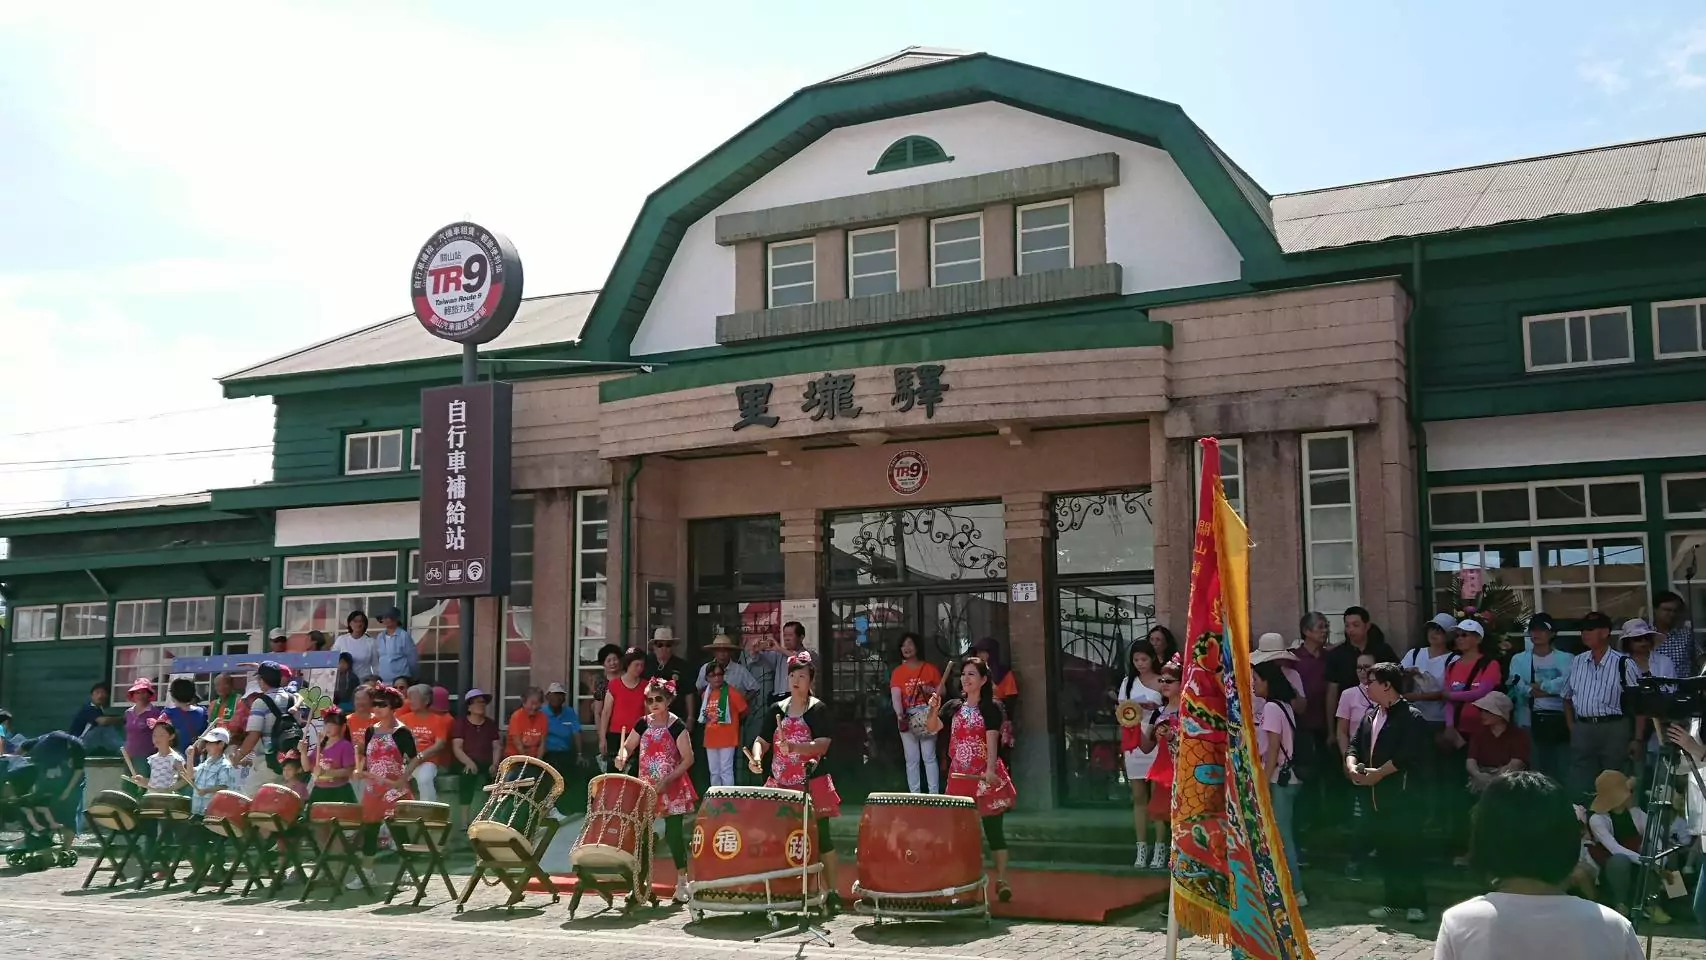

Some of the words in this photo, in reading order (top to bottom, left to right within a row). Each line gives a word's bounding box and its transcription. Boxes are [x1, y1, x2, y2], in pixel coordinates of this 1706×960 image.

[435, 297, 457, 306] Taiwan
[458, 294, 476, 302] Route
[445, 399, 467, 551] 自行車補給站
[895, 462, 921, 477] TR9
[1025, 592, 1030, 601] 6
[716, 830, 738, 853] 福
